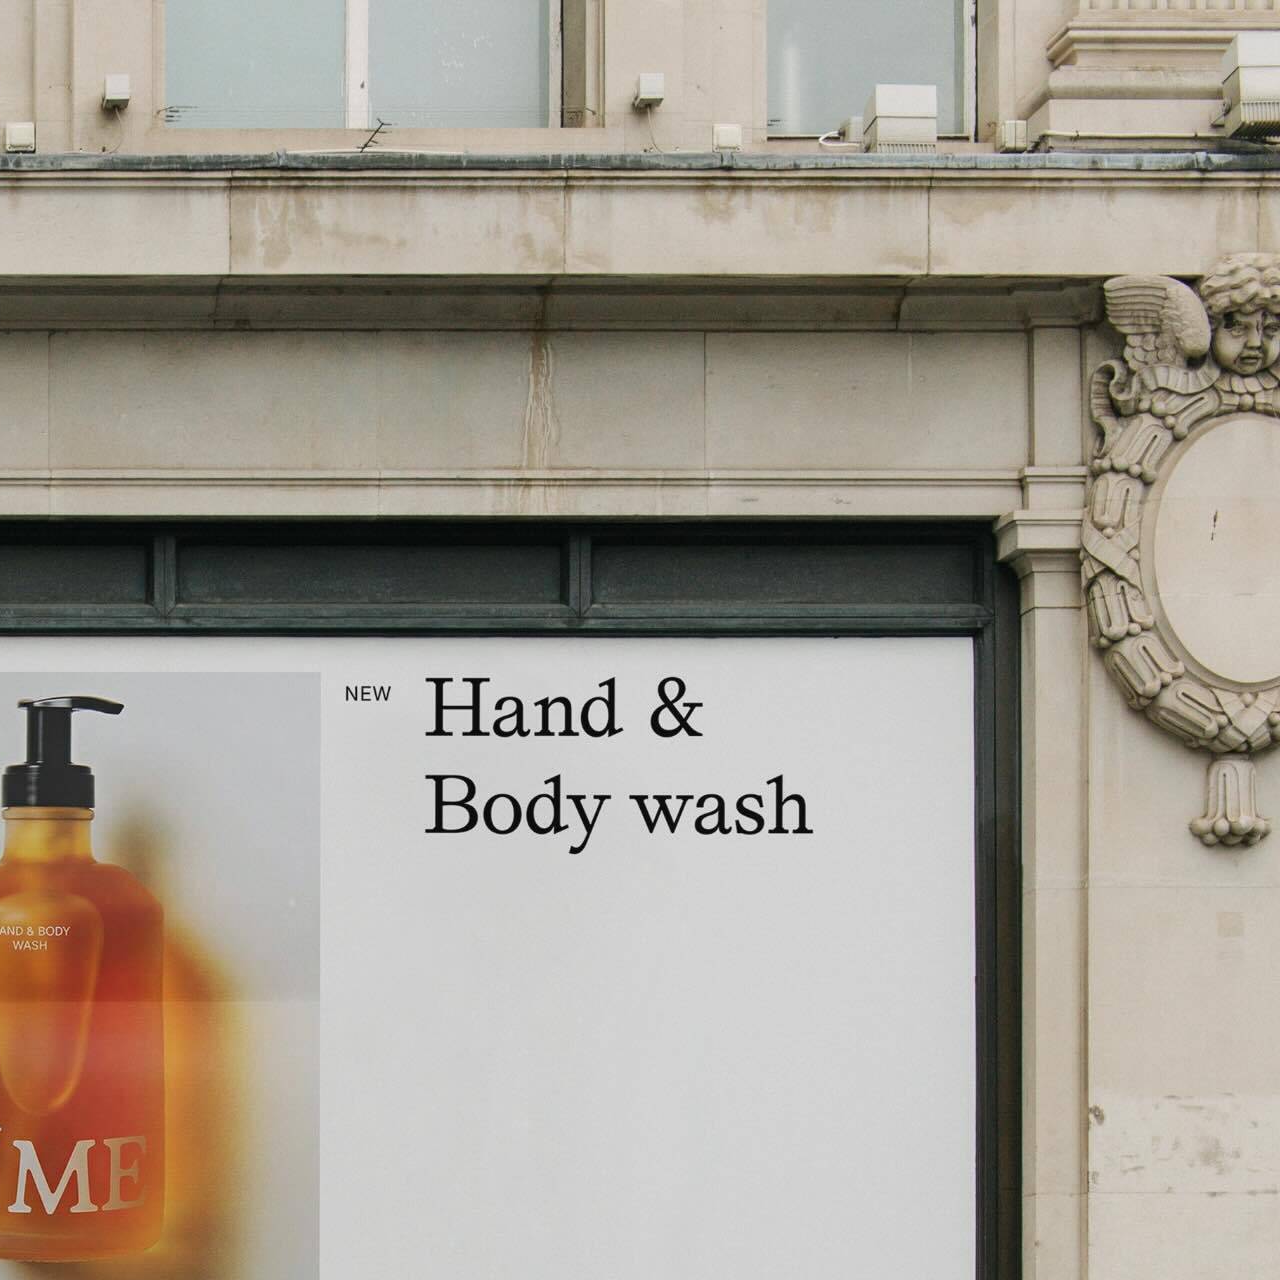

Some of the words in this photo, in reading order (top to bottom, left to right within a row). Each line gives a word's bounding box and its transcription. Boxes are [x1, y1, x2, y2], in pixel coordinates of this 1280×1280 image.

[345, 685, 392, 702] NEW
[424, 676, 624, 738] Hand
[650, 676, 704, 738] &
[424, 773, 612, 855] Body
[628, 774, 814, 836] wash
[26, 926, 35, 937] &
[38, 926, 72, 937] BODY
[12, 940, 49, 951] WASH
